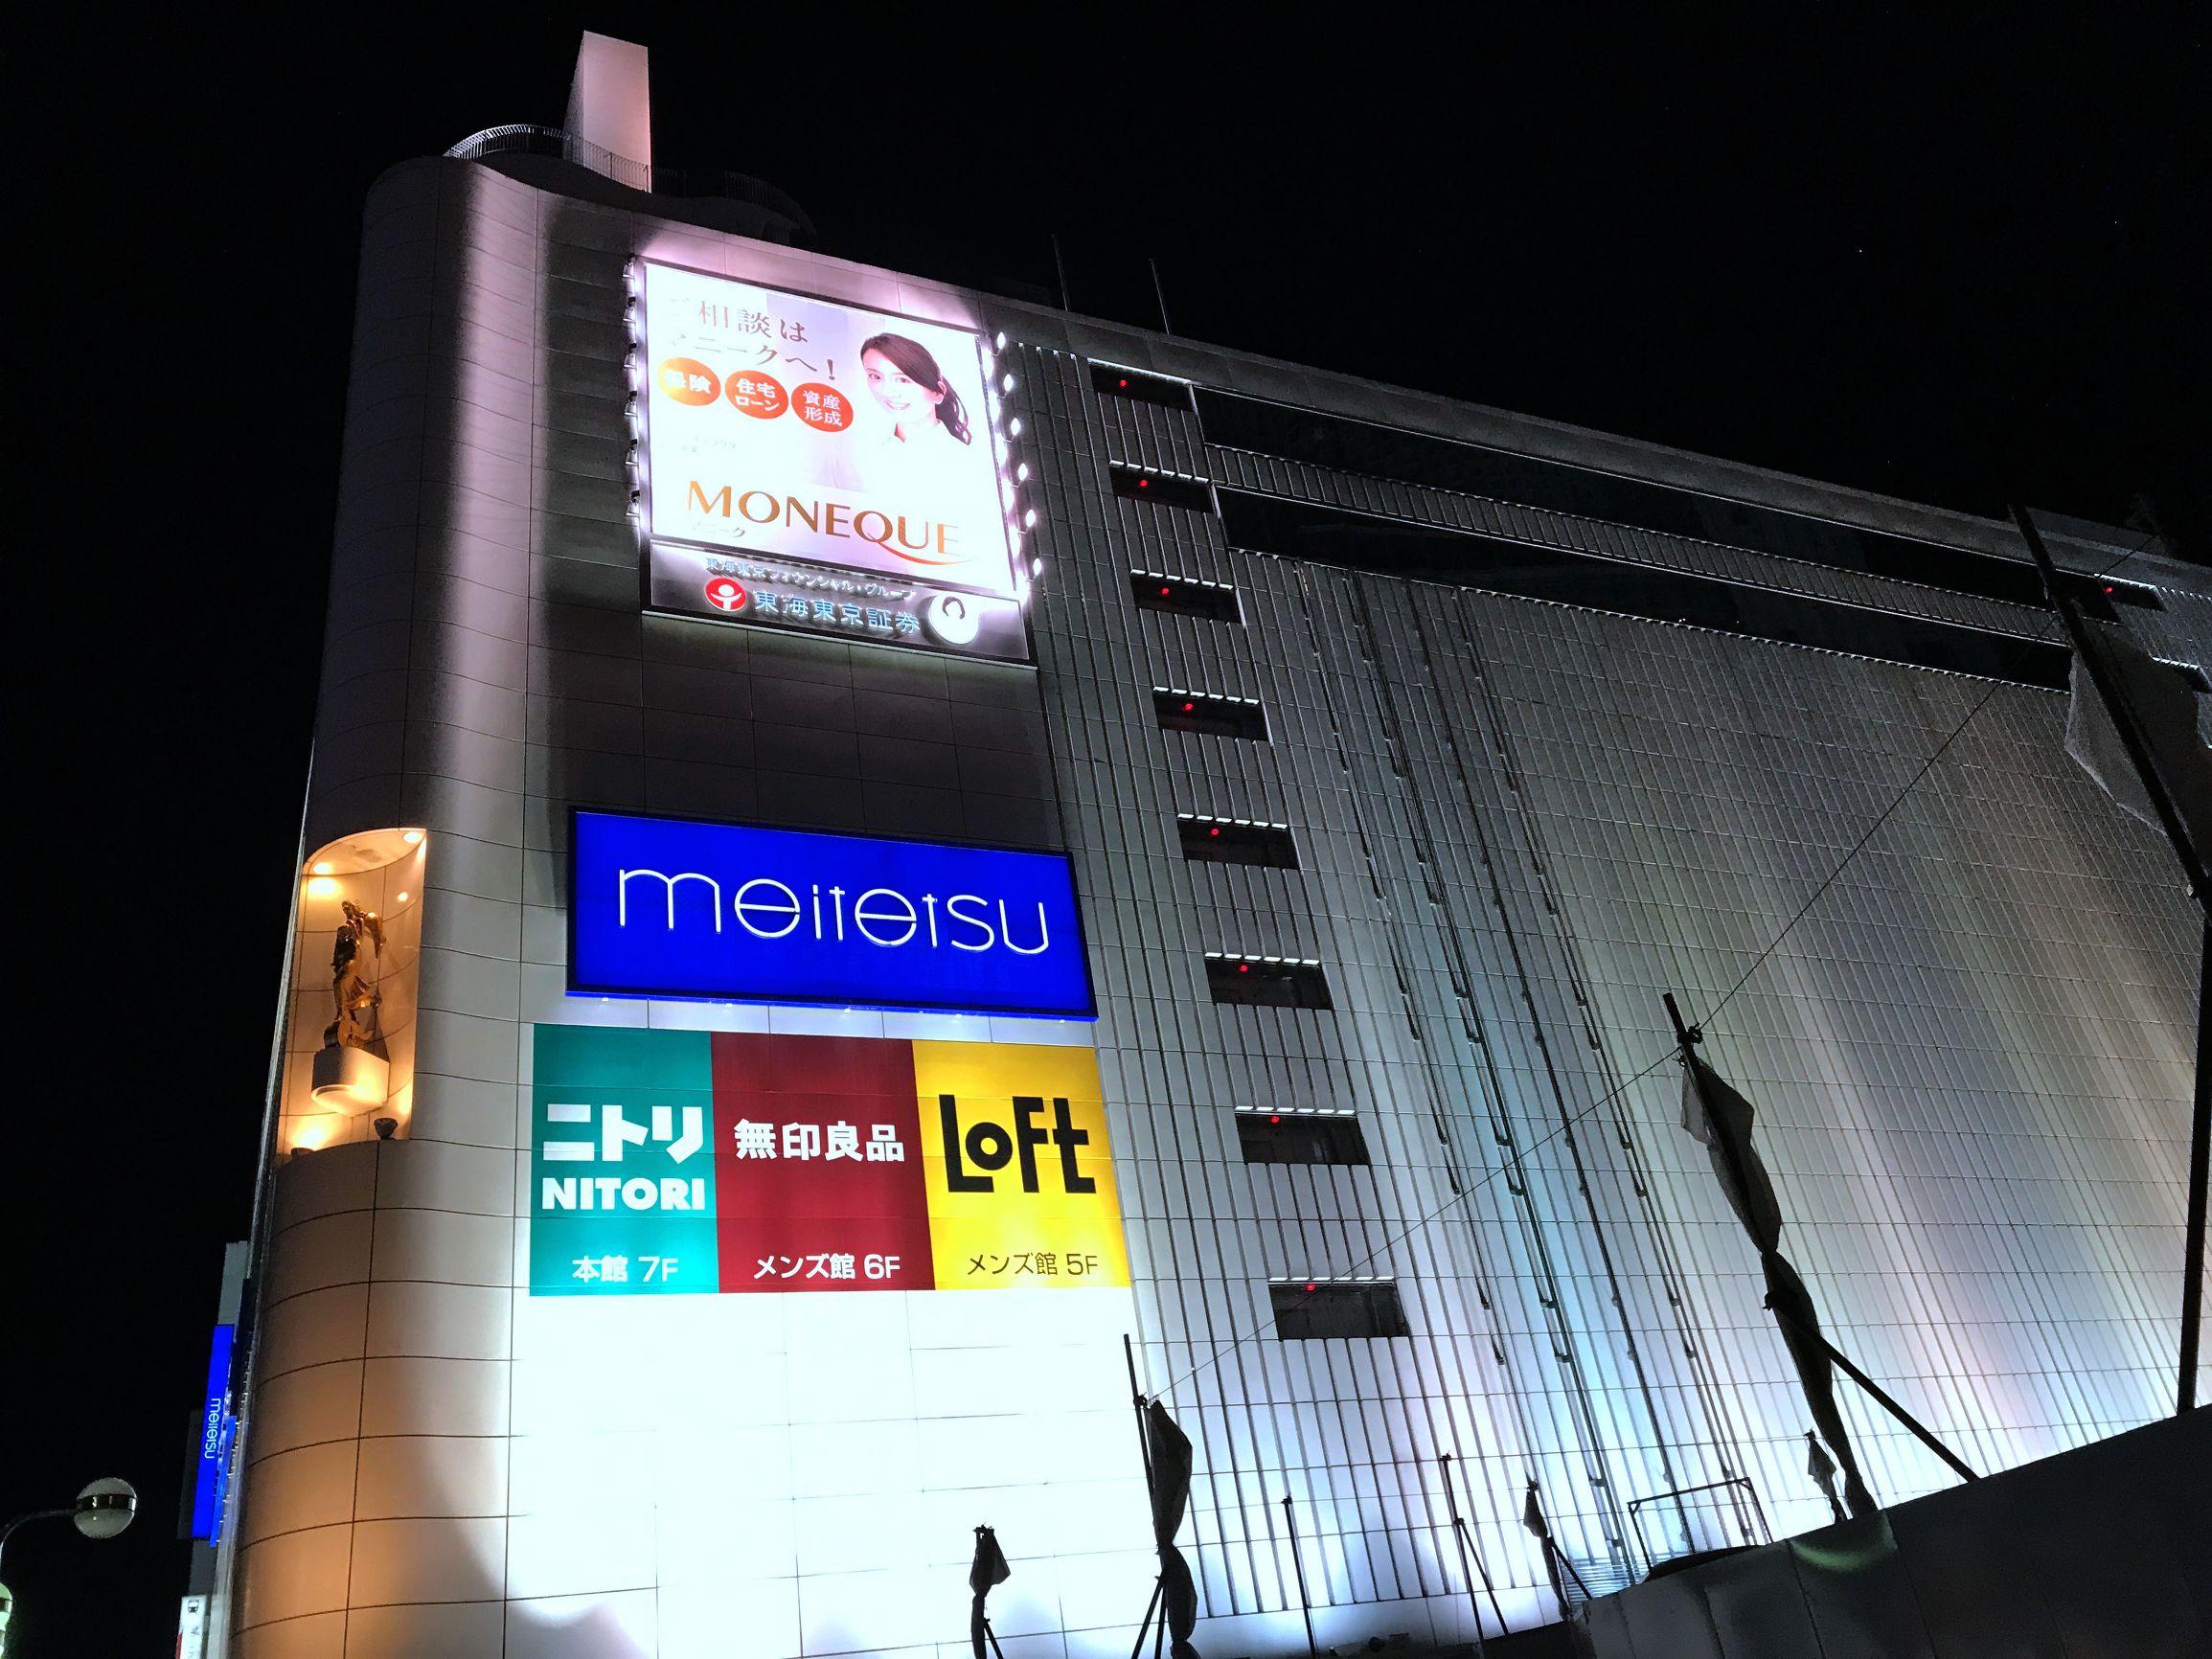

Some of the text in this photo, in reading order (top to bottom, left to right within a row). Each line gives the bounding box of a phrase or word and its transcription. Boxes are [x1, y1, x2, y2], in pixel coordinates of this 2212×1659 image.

[671, 297, 809, 343] 相談は
[735, 395, 781, 411] ローン
[736, 377, 776, 398] 住宅
[803, 390, 841, 411] 資産
[804, 406, 843, 427] 形成
[688, 480, 966, 565] MONEQUE
[753, 589, 921, 634] 東海東京証券
[618, 869, 1051, 955] meitetsu
[542, 1102, 704, 1165] ニトリ
[734, 1119, 905, 1163] 無印良品
[541, 1177, 705, 1212] NITORI
[572, 1256, 679, 1284] 本館 7F
[753, 1255, 901, 1281] メンズ館 6F
[967, 1253, 1099, 1276] メンズ館 5F
